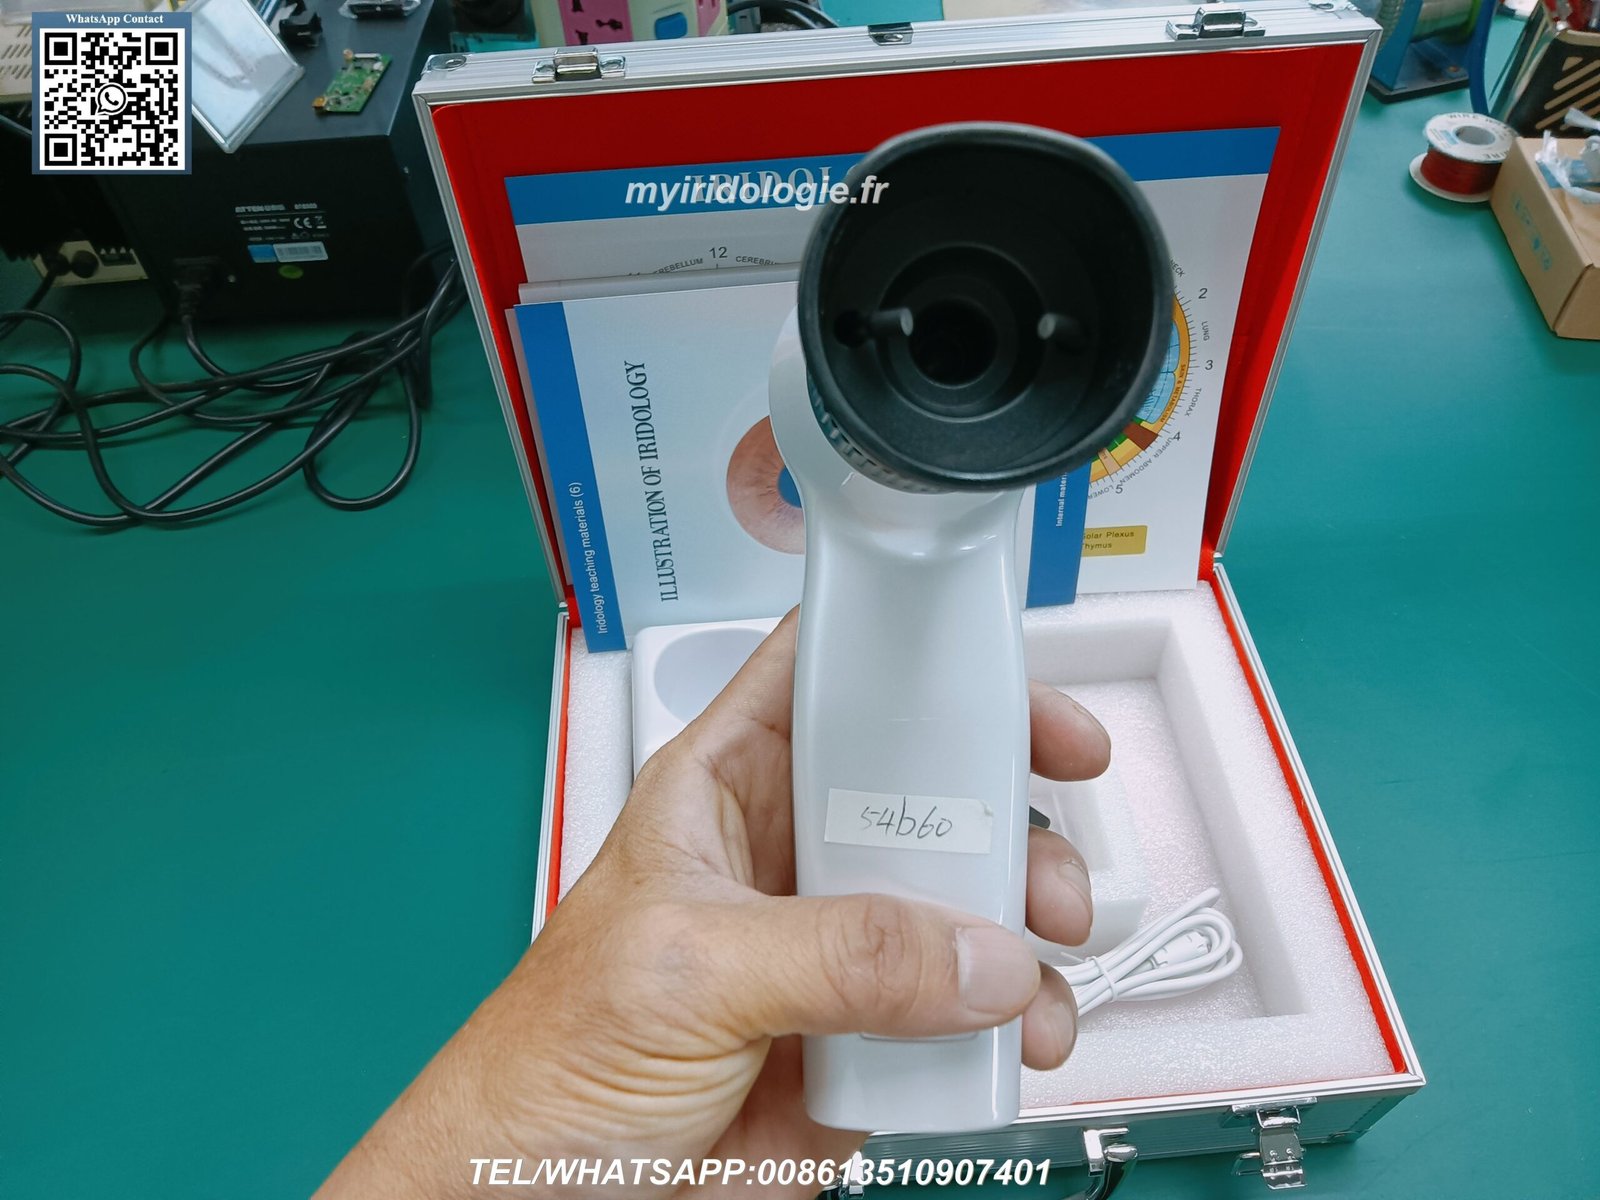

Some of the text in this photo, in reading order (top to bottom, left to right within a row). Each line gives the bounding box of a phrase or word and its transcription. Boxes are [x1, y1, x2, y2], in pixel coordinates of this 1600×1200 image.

[709, 246, 728, 259] 12
[735, 255, 777, 265] CEREBR
[653, 257, 704, 274] REBELLUM
[1198, 287, 1208, 299] 2
[1201, 320, 1210, 342] LUNG
[1204, 359, 1214, 371] 3
[1184, 387, 1202, 417] THORAX
[1173, 431, 1181, 442] 4
[1120, 436, 1174, 486] UPPER ABDOMEN
[624, 360, 679, 602] ILLUSTRATION OF IRIDOLOGY
[1115, 484, 1124, 495] 5
[1055, 471, 1069, 527] Internal materi
[1106, 531, 1135, 539] Plexus
[568, 481, 608, 634] Iridology teaching materials (6)
